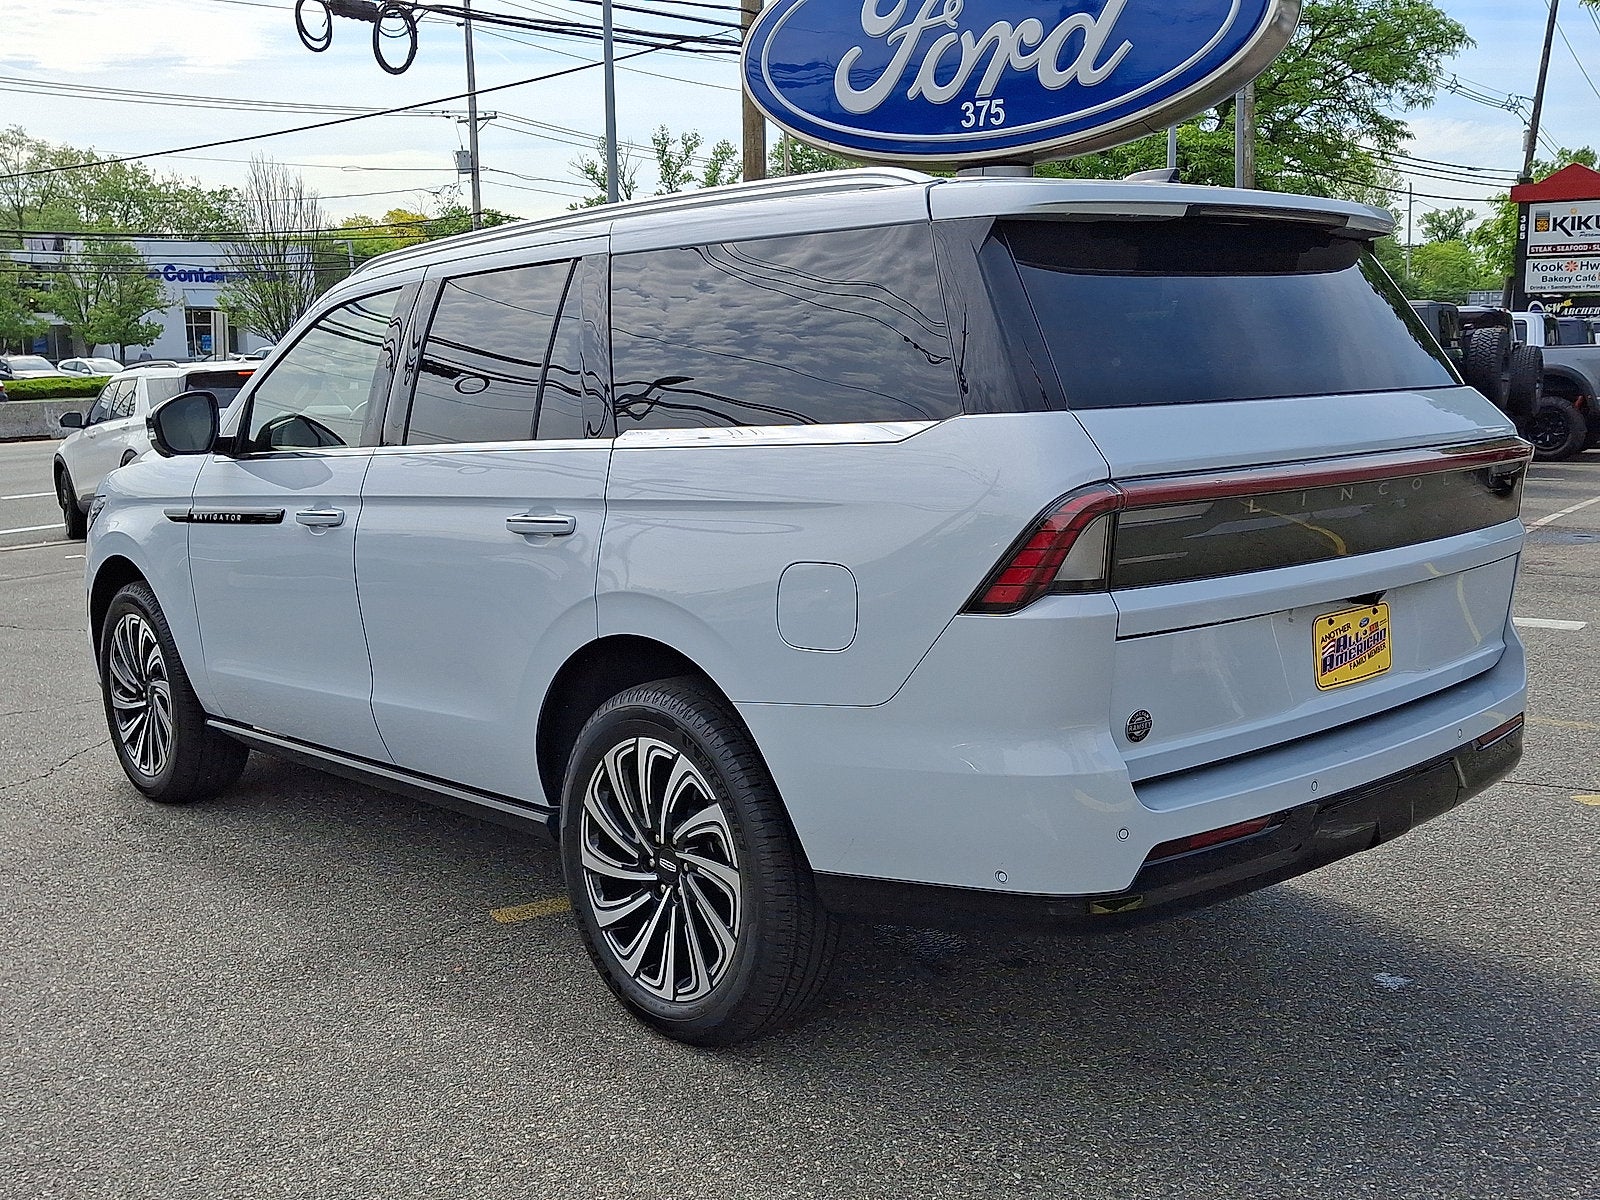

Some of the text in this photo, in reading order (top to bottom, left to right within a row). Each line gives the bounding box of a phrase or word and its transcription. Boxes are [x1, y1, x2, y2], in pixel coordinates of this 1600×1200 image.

[834, 0, 1134, 114] Ford
[960, 99, 1006, 128] 375
[1556, 244, 1589, 252] SEAFOOD
[1532, 261, 1564, 272] Kook
[1541, 274, 1597, 283] Bakery Café
[193, 513, 241, 521] NAVIGATOR
[1321, 623, 1351, 644] ANOTHER
[1336, 632, 1362, 653] ALL
[1350, 642, 1386, 670] FAMILY MEMBER
